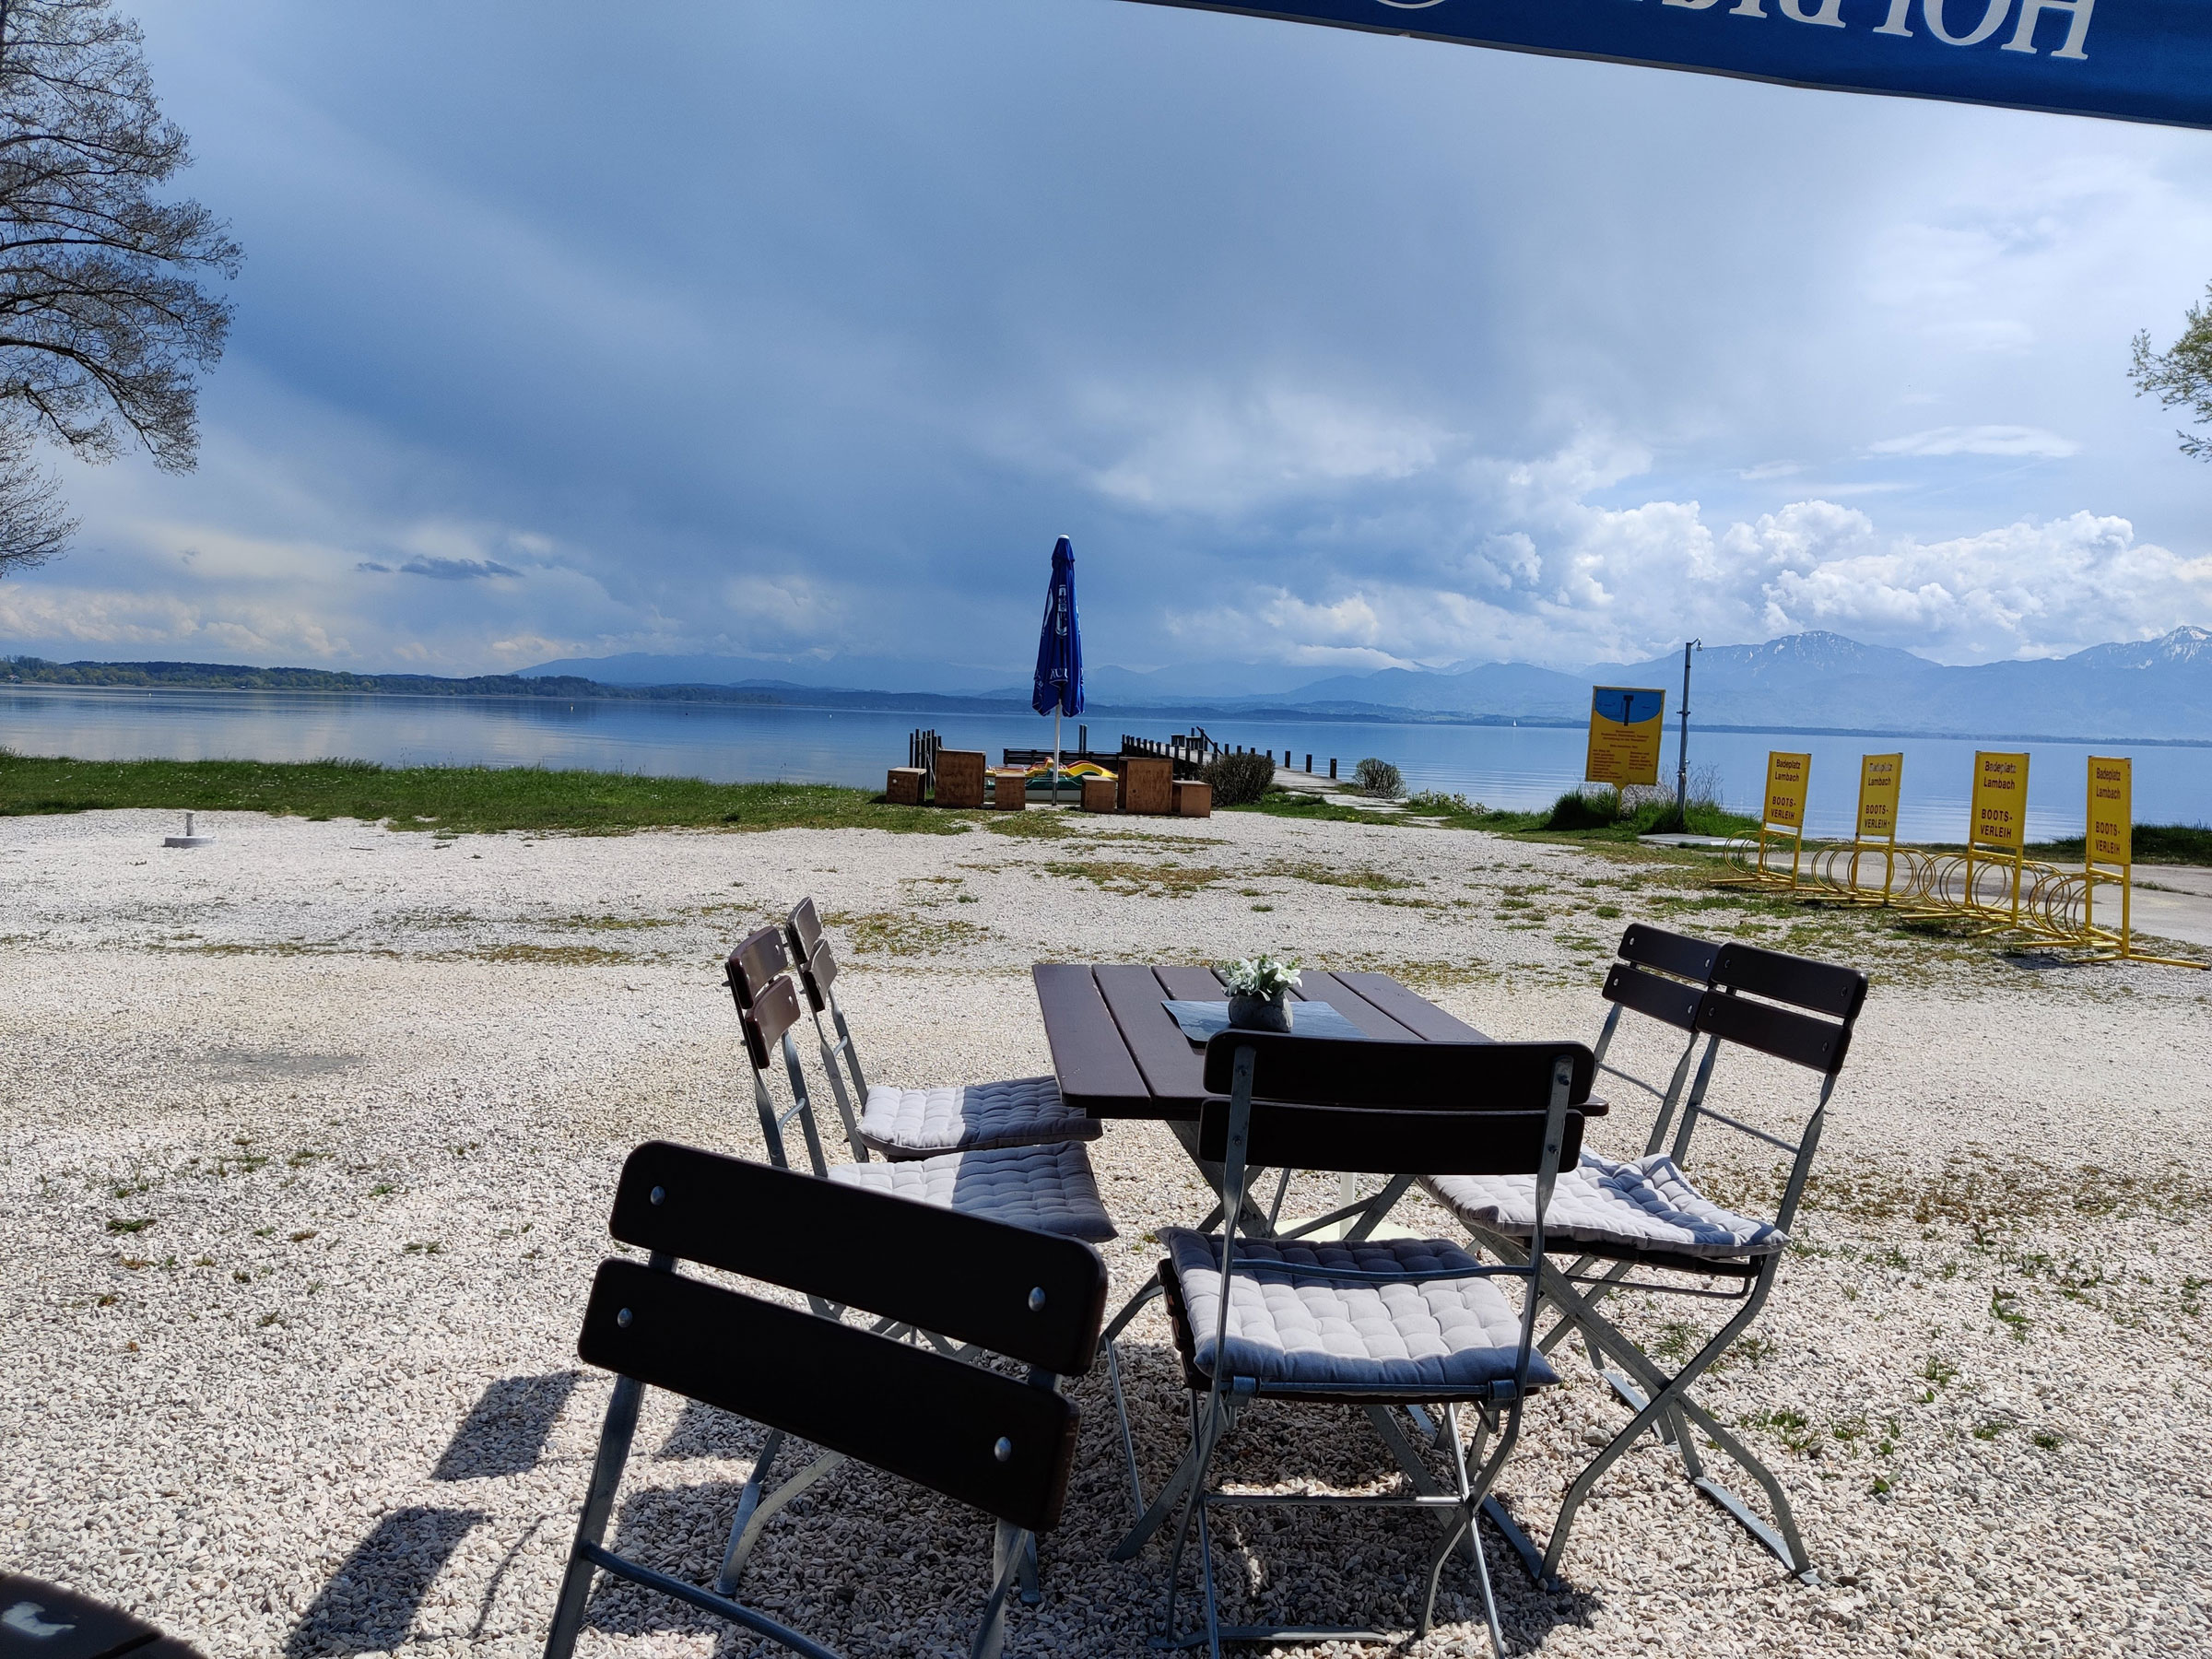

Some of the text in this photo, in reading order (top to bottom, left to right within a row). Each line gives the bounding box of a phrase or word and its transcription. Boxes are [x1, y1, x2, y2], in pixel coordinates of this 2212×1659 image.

[1776, 759, 1801, 770] Badeplatz
[1984, 760, 2017, 774] Badeplatz
[1774, 771, 1799, 782] Lambach
[1867, 777, 1891, 786] Lambach
[2096, 767, 2121, 782] Badeplatz
[1983, 776, 2016, 790] Lambach
[2096, 784, 2121, 800] Lambach
[1771, 795, 1796, 807] BOOTS-
[1771, 808, 1795, 820] VERLEIH
[1865, 804, 1888, 815] BOOTS-
[1981, 808, 2013, 822] BOOTS-
[1980, 824, 2012, 839] VERLEIH
[2095, 821, 2121, 837] BOOTS-
[2095, 839, 2121, 855] VERLEIH
